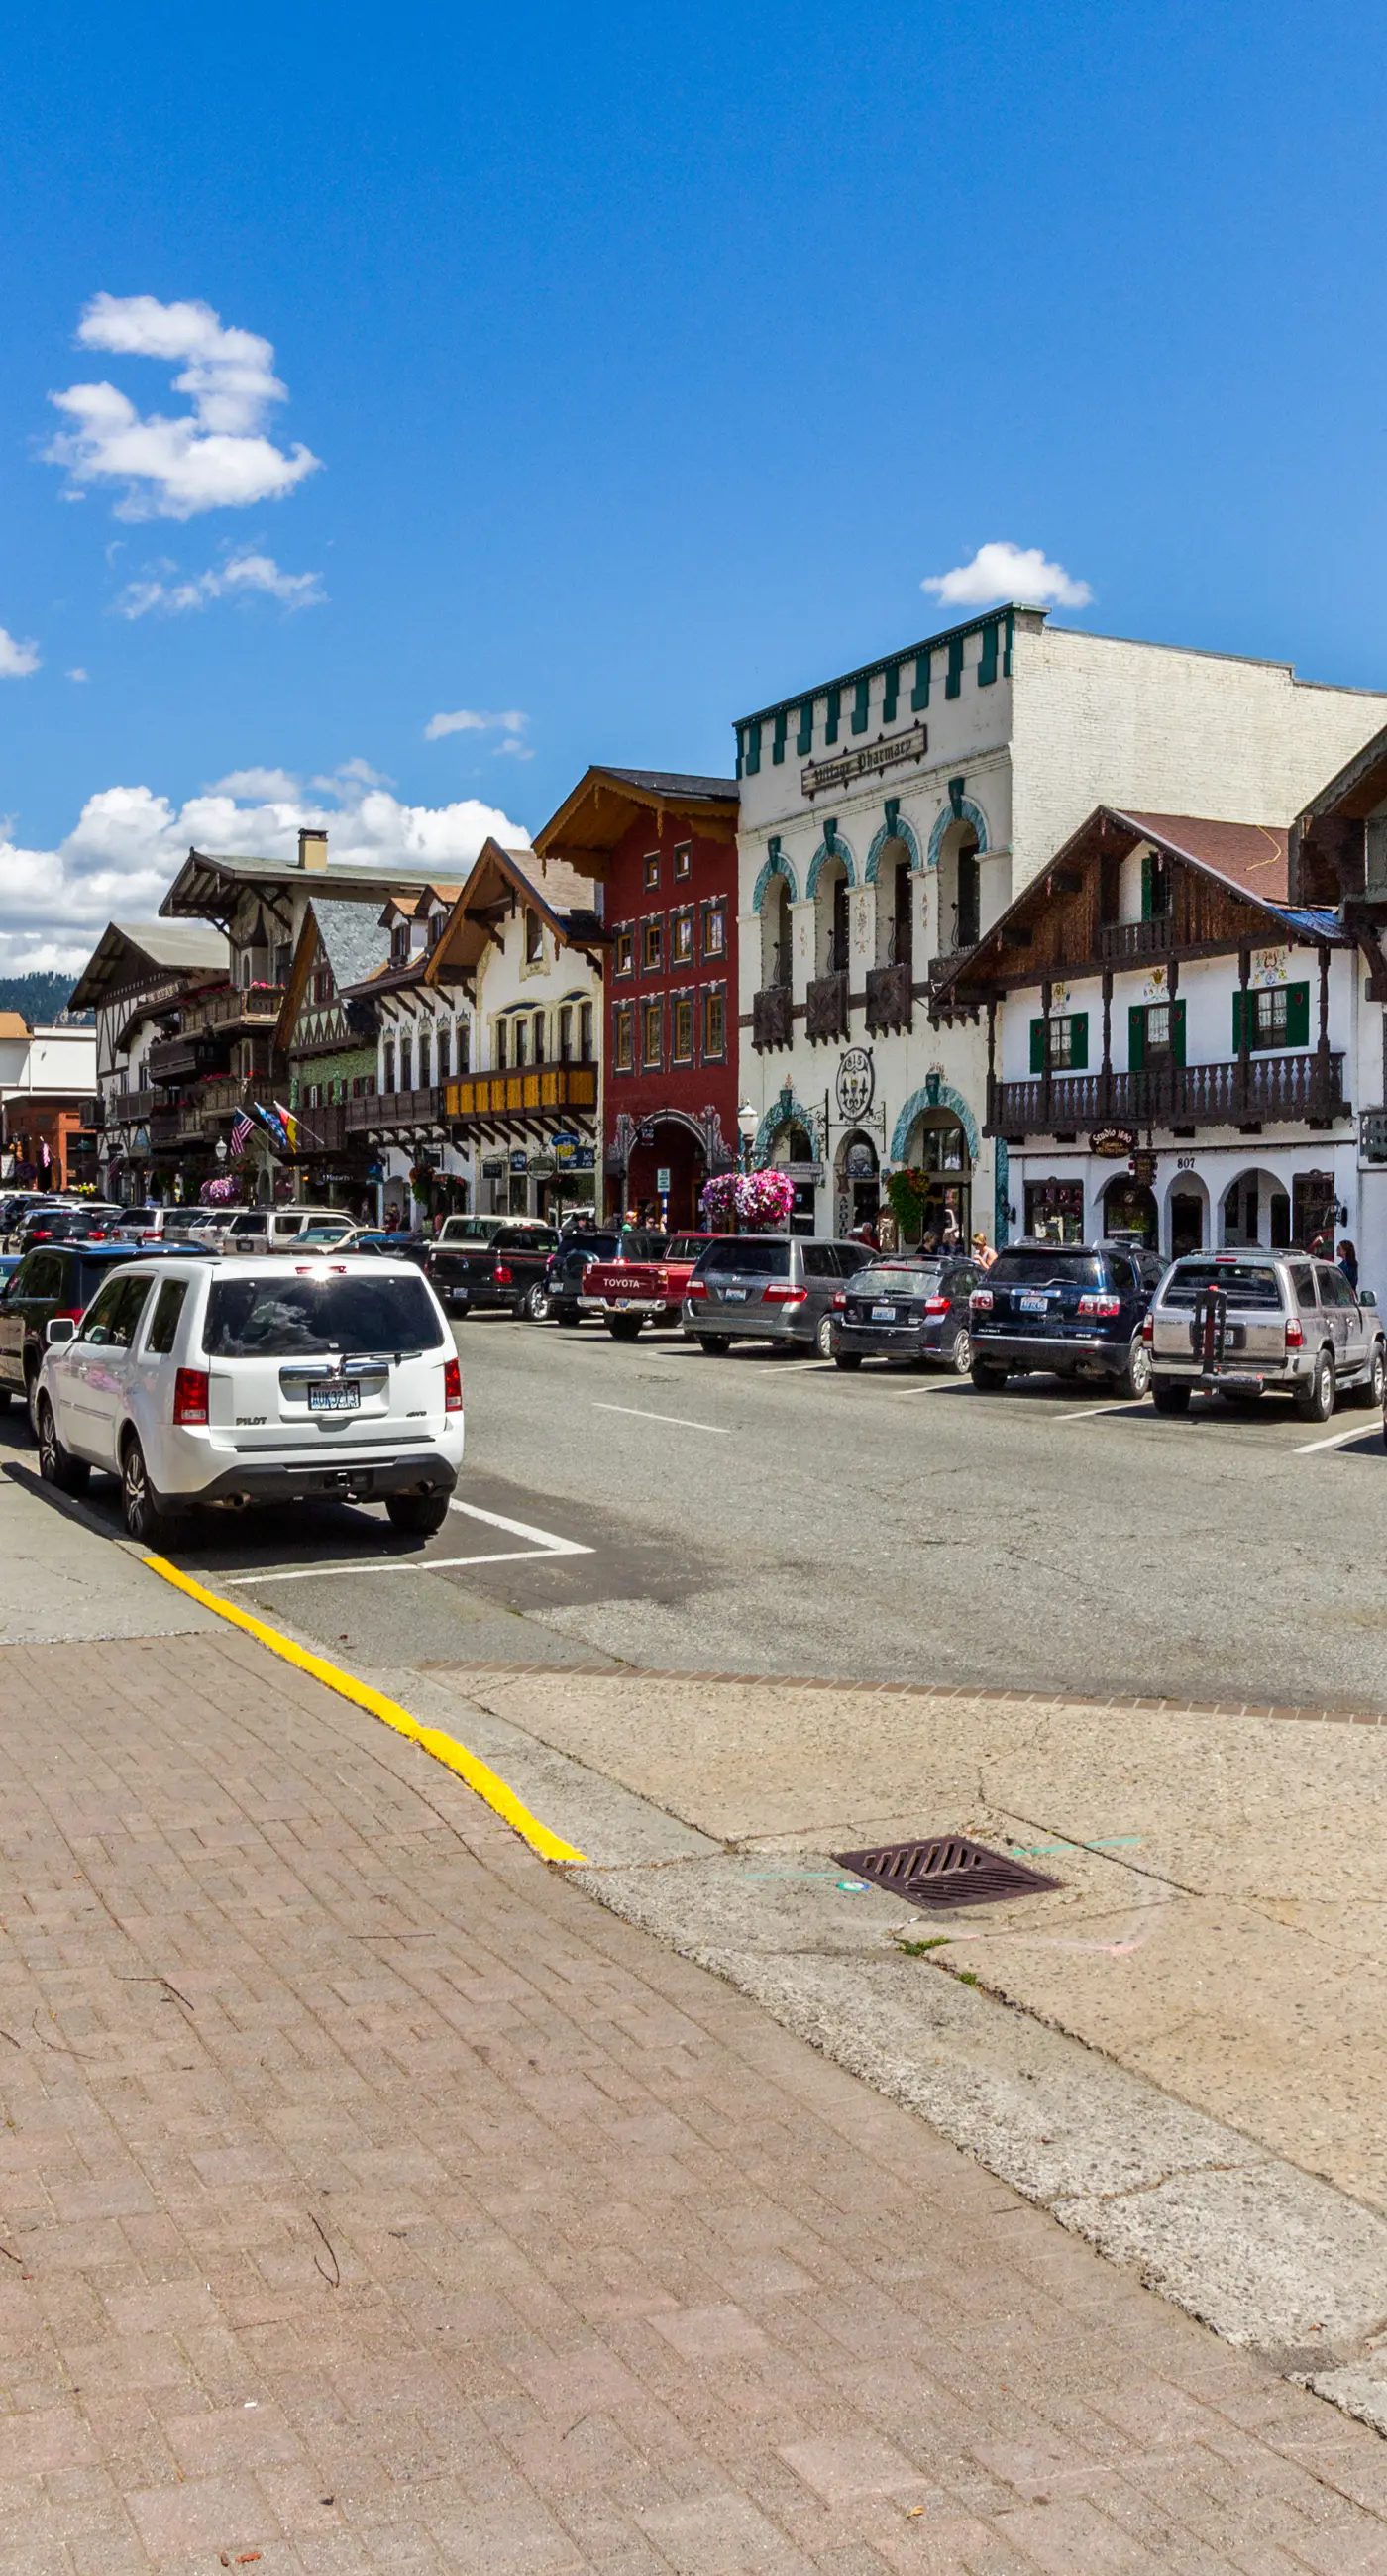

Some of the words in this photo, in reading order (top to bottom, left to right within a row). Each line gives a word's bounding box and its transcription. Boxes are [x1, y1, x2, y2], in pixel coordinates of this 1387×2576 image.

[857, 739, 912, 773] Pharmacy
[847, 1054, 863, 1067] 815
[1092, 1127, 1117, 1144] Studio
[1177, 1157, 1195, 1169] 807
[603, 1278, 640, 1288] TOYOTA
[312, 1390, 357, 1405] AUK3213
[236, 1416, 267, 1426] PILOT
